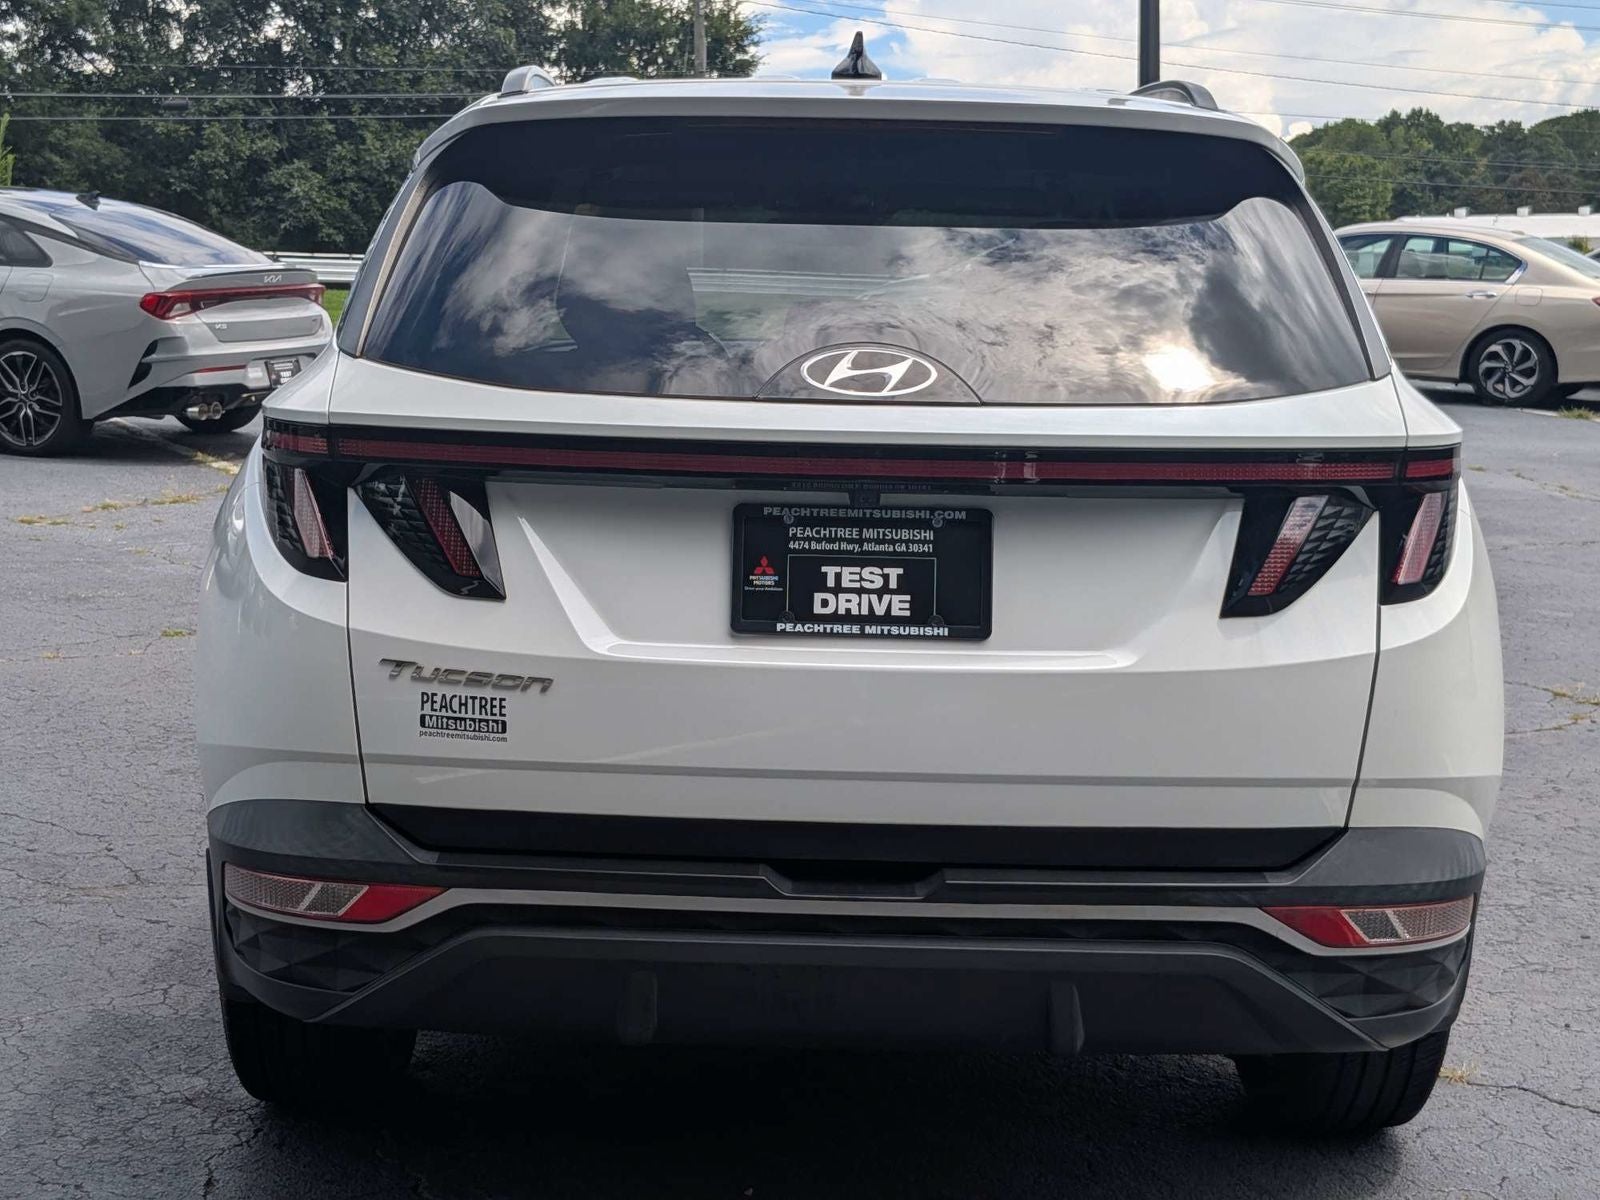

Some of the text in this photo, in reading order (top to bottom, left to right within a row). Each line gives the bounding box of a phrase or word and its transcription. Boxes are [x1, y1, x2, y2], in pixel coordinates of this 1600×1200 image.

[763, 506, 967, 520] PEACHTREEMITSUBISHI.COM
[788, 526, 934, 541] PEACHTREE MITSUBISHI
[788, 541, 933, 553] 4474 Buford Hwy, Atlanta GA 30341
[821, 565, 903, 589] TEST
[813, 592, 911, 617] DRIVE
[776, 623, 949, 636] PEACHTREE MITSUBISHI
[420, 692, 507, 717] PEACHTREE
[424, 715, 503, 733] Mitsubishi
[419, 730, 508, 742] peachtreemitsubishi.com
